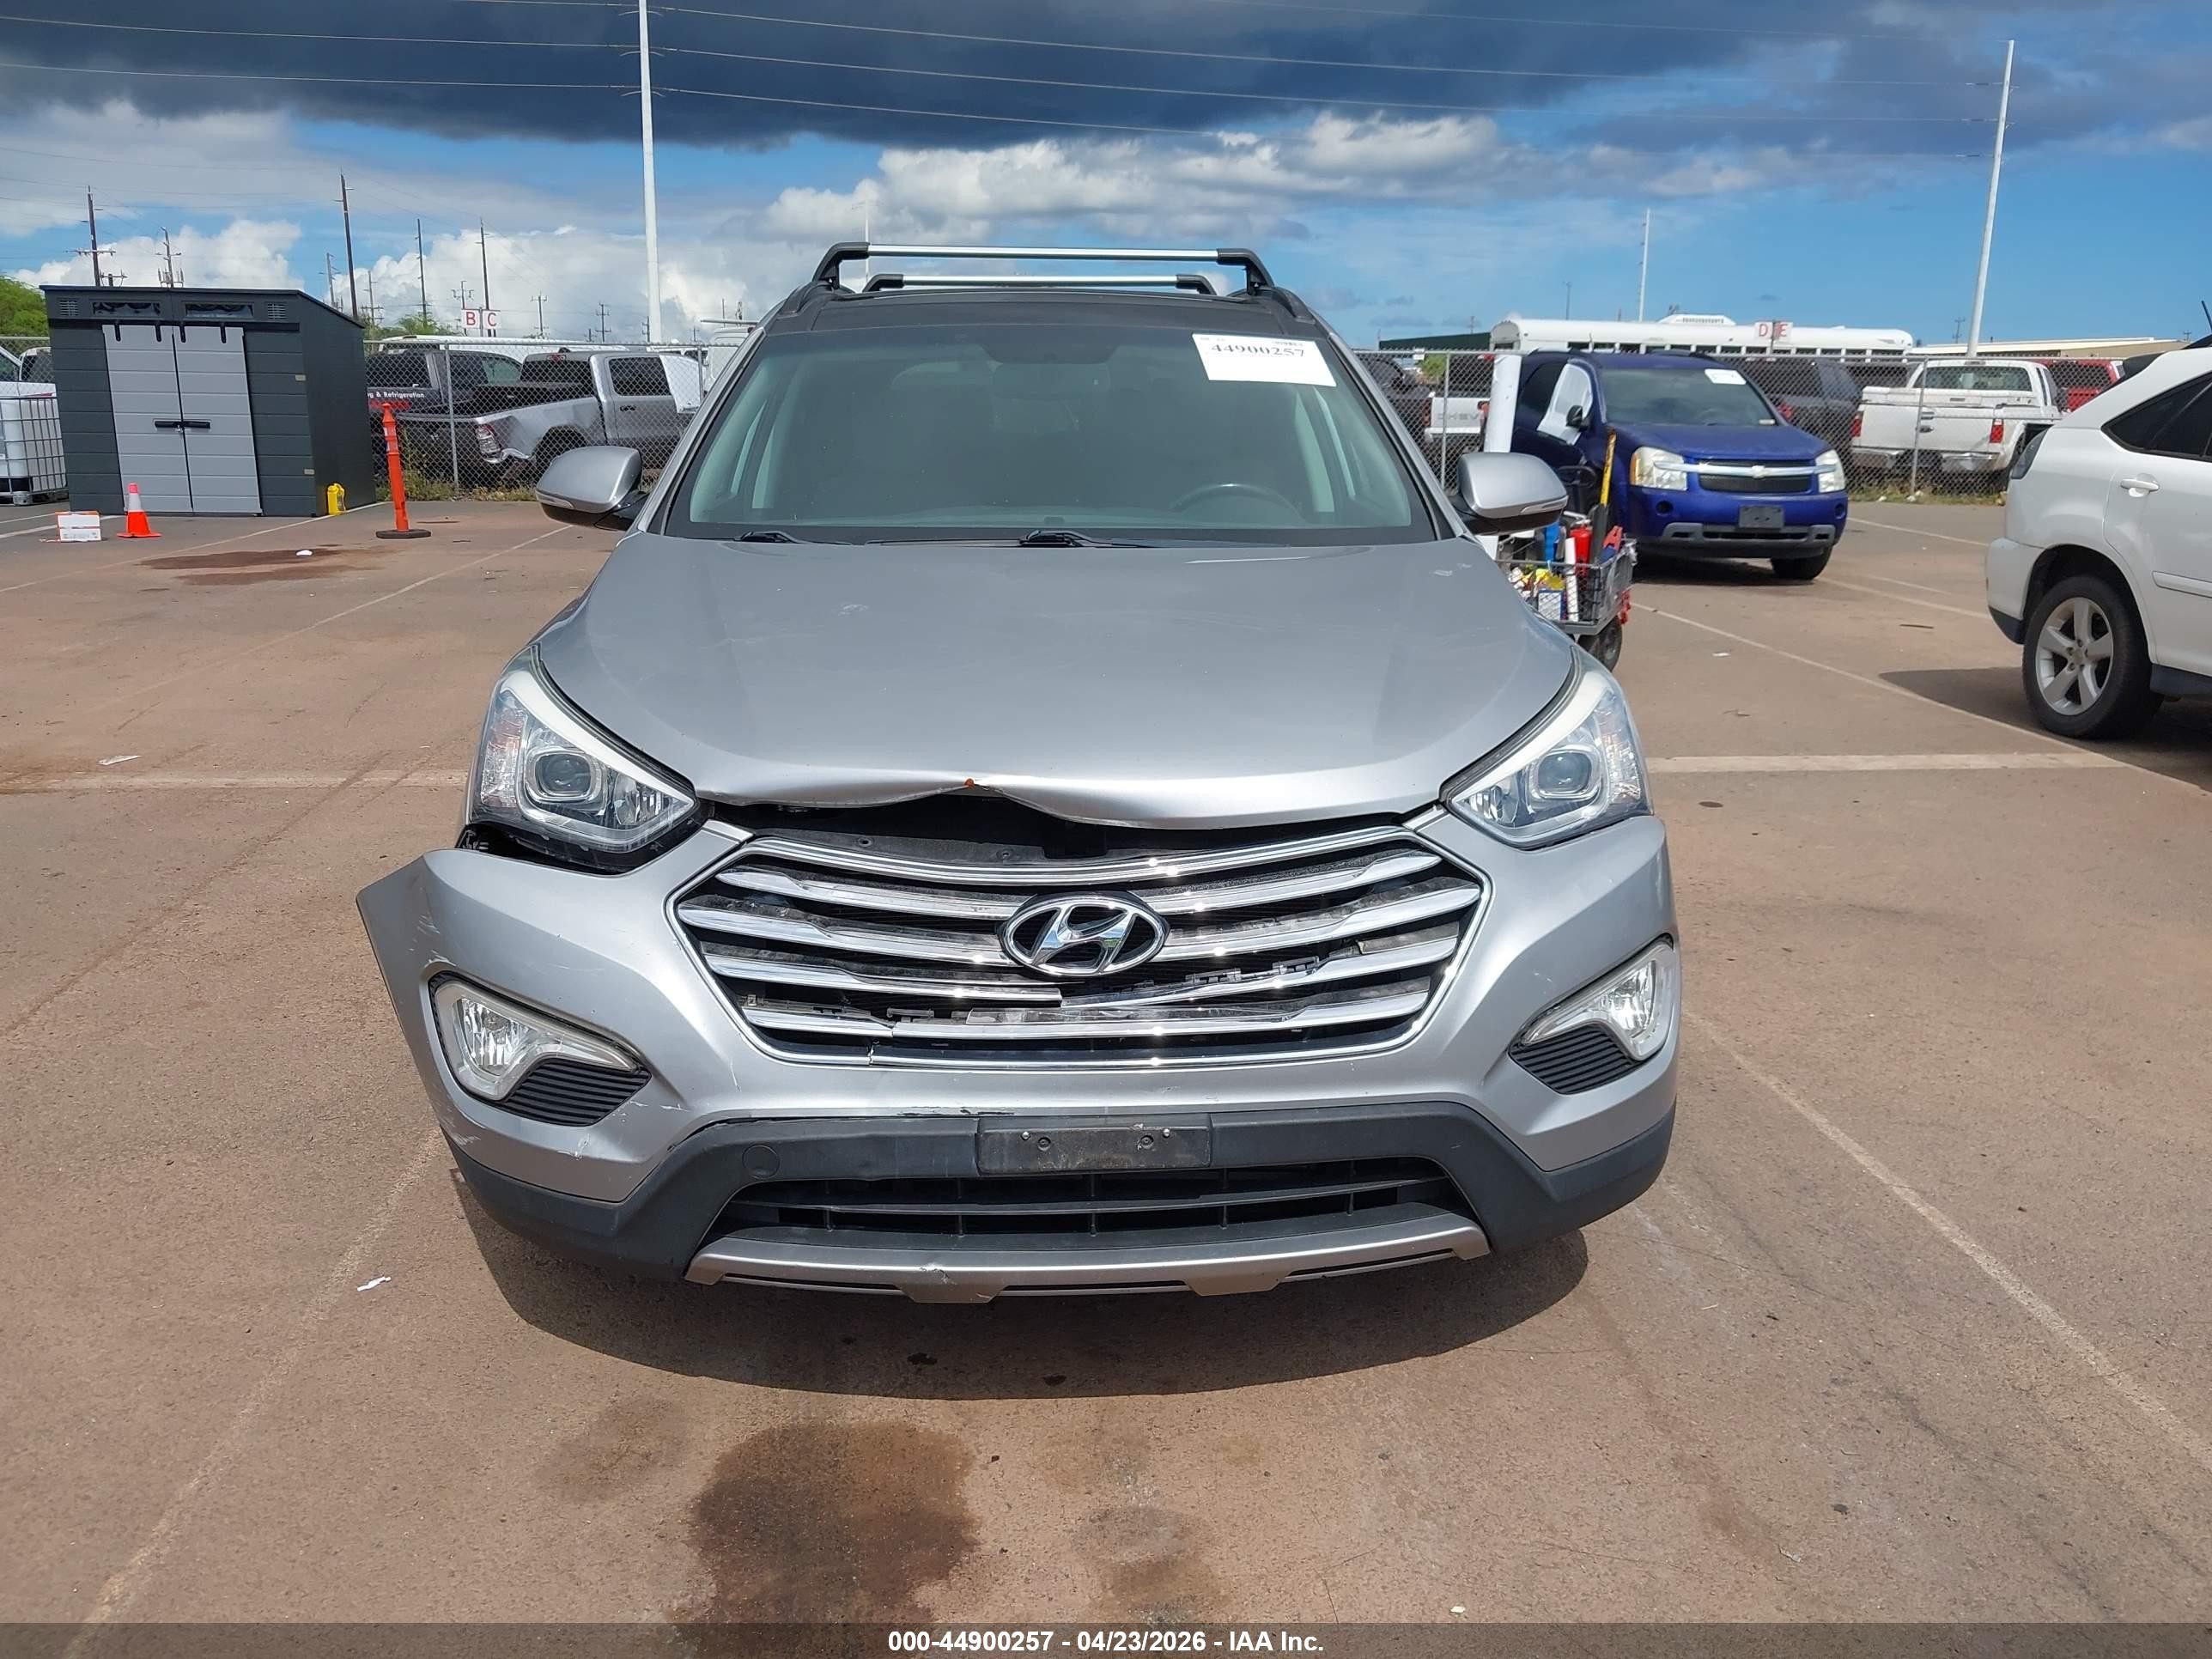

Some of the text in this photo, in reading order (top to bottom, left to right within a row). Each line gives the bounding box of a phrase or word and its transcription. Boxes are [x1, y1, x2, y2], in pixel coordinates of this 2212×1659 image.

[466, 312, 476, 325] B
[488, 313, 497, 326] C
[1759, 324, 1768, 337] D
[1778, 323, 1788, 337] E
[1211, 343, 1304, 357] 44900257
[383, 391, 425, 399] Refrigeration
